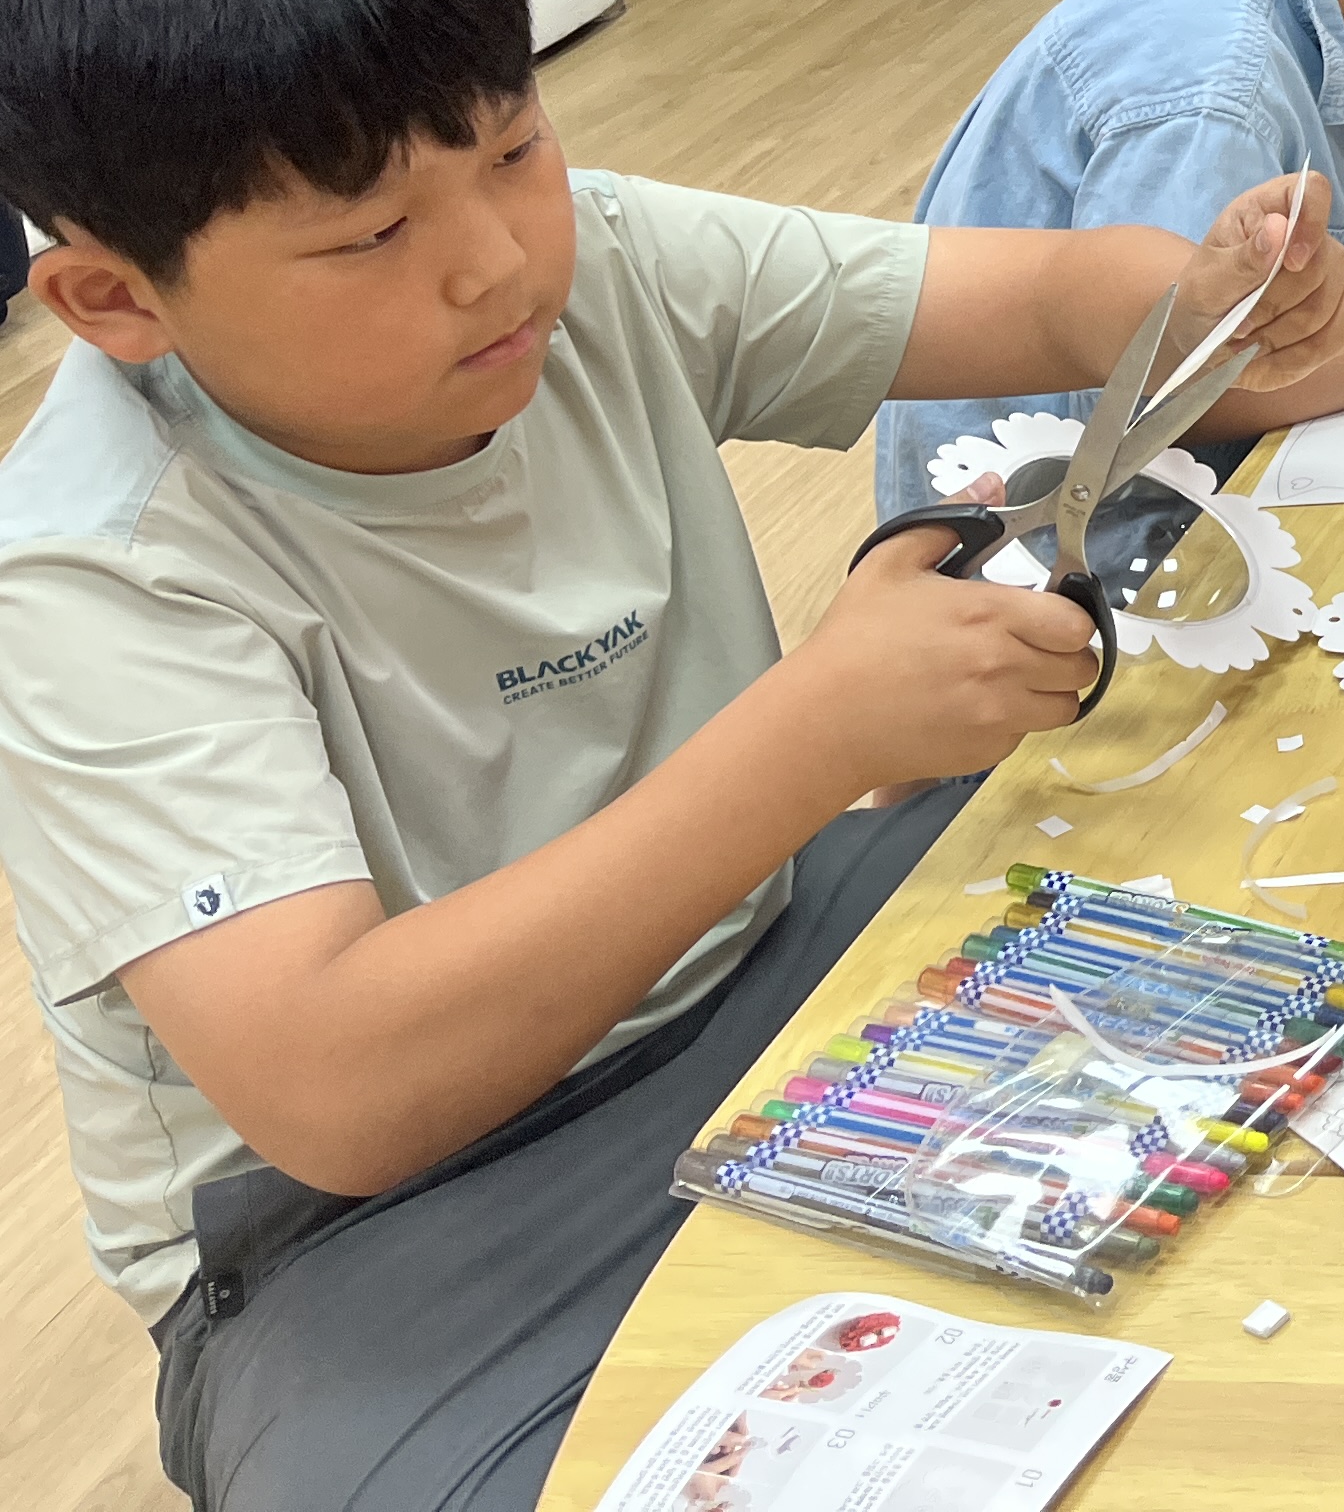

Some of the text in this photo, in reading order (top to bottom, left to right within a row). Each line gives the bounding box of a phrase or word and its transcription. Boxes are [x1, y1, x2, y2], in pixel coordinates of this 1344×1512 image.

[503, 629, 650, 705] CREATE BETTER FUTURE
[934, 1326, 964, 1346] 02
[824, 1426, 856, 1452] 03
[1015, 1468, 1043, 1489] 01
